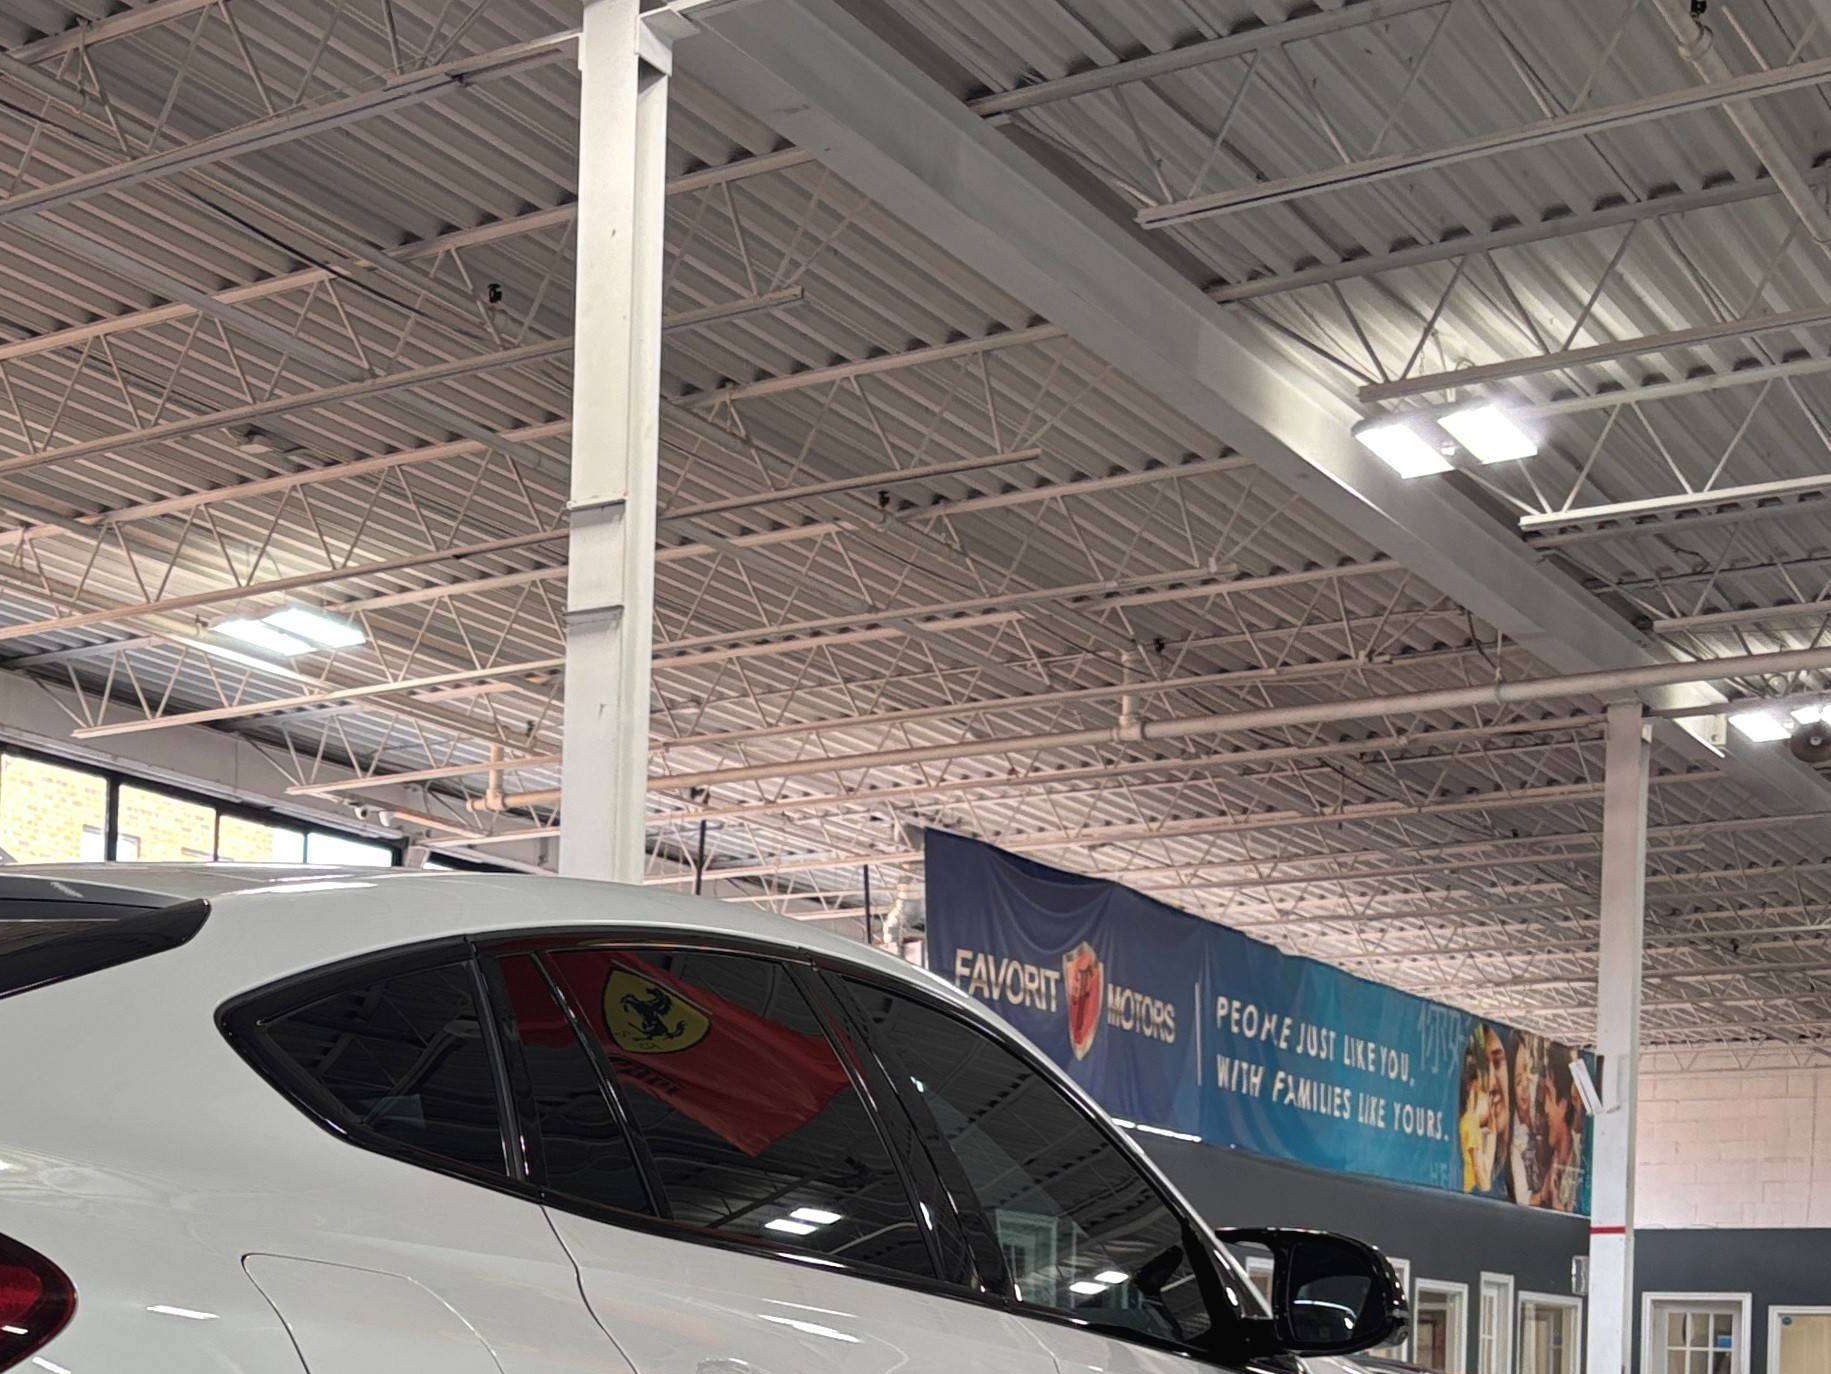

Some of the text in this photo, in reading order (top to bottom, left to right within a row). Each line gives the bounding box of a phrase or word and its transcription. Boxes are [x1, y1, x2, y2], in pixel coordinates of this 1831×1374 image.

[954, 948, 1175, 1043] FAVORIT MOTORS
[1216, 1054, 1449, 1141] WITH FAMILIES LIKE YOURS.
[1296, 1022, 1336, 1061] JUST
[1344, 1034, 1375, 1072] LIKE
[1380, 1045, 1415, 1087] YOU.
